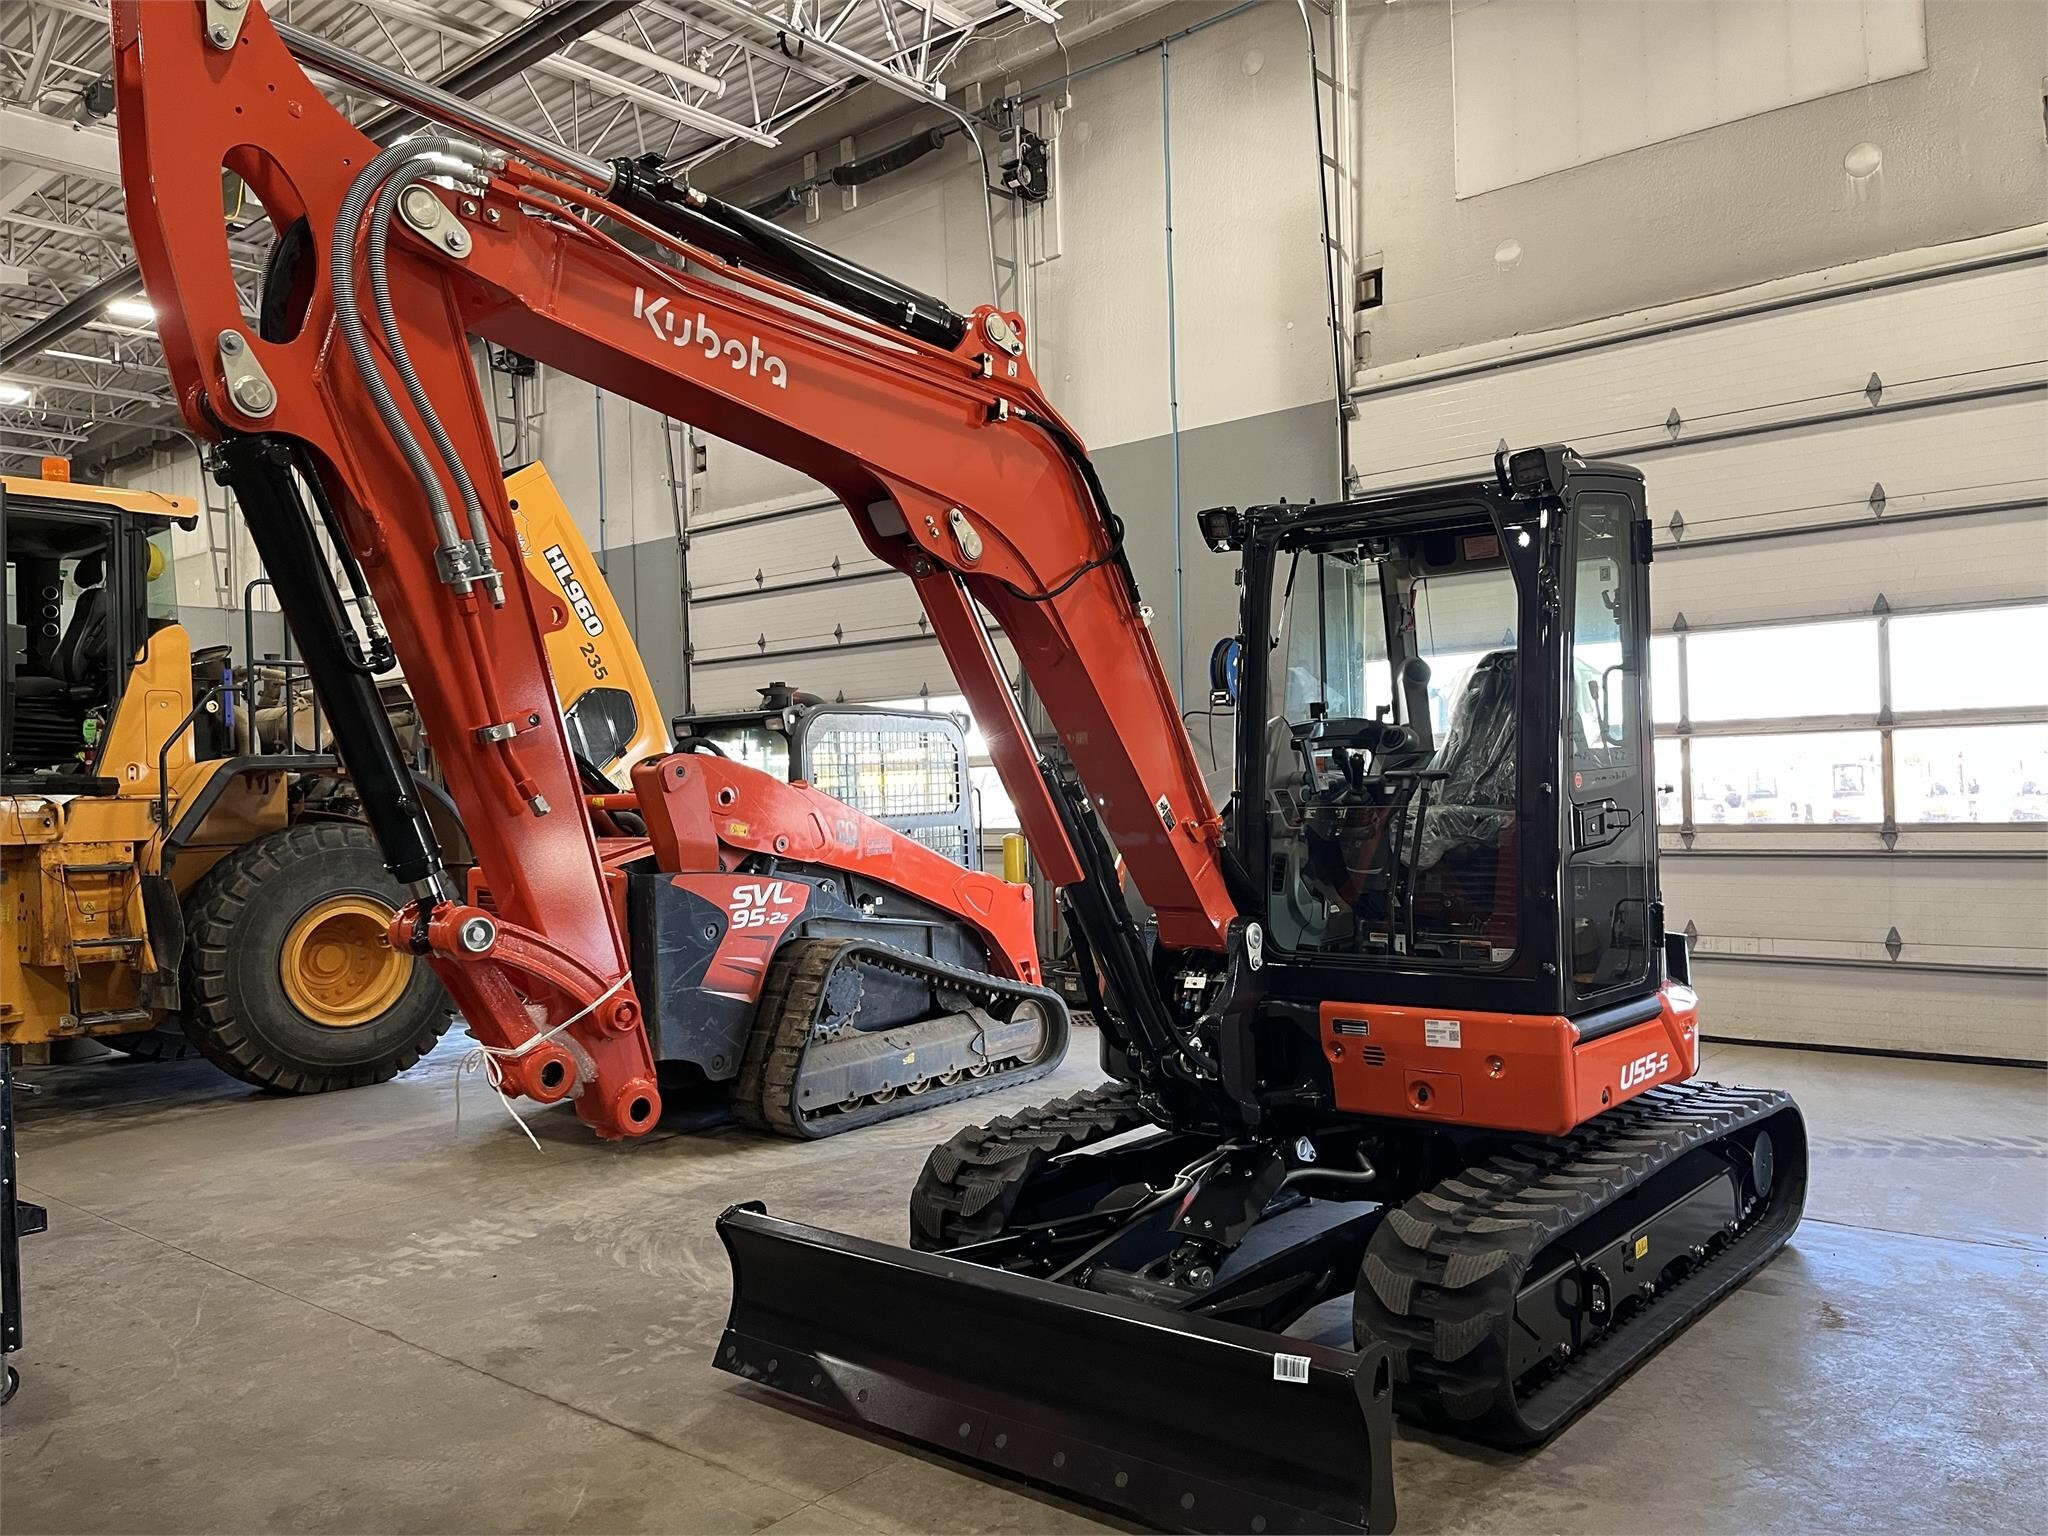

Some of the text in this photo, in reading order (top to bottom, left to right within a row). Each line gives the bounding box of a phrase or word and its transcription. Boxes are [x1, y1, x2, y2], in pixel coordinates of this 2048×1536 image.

[633, 286, 788, 389] Kubota
[543, 544, 604, 637] HL960
[579, 642, 608, 681] 235
[729, 881, 794, 910] SVL
